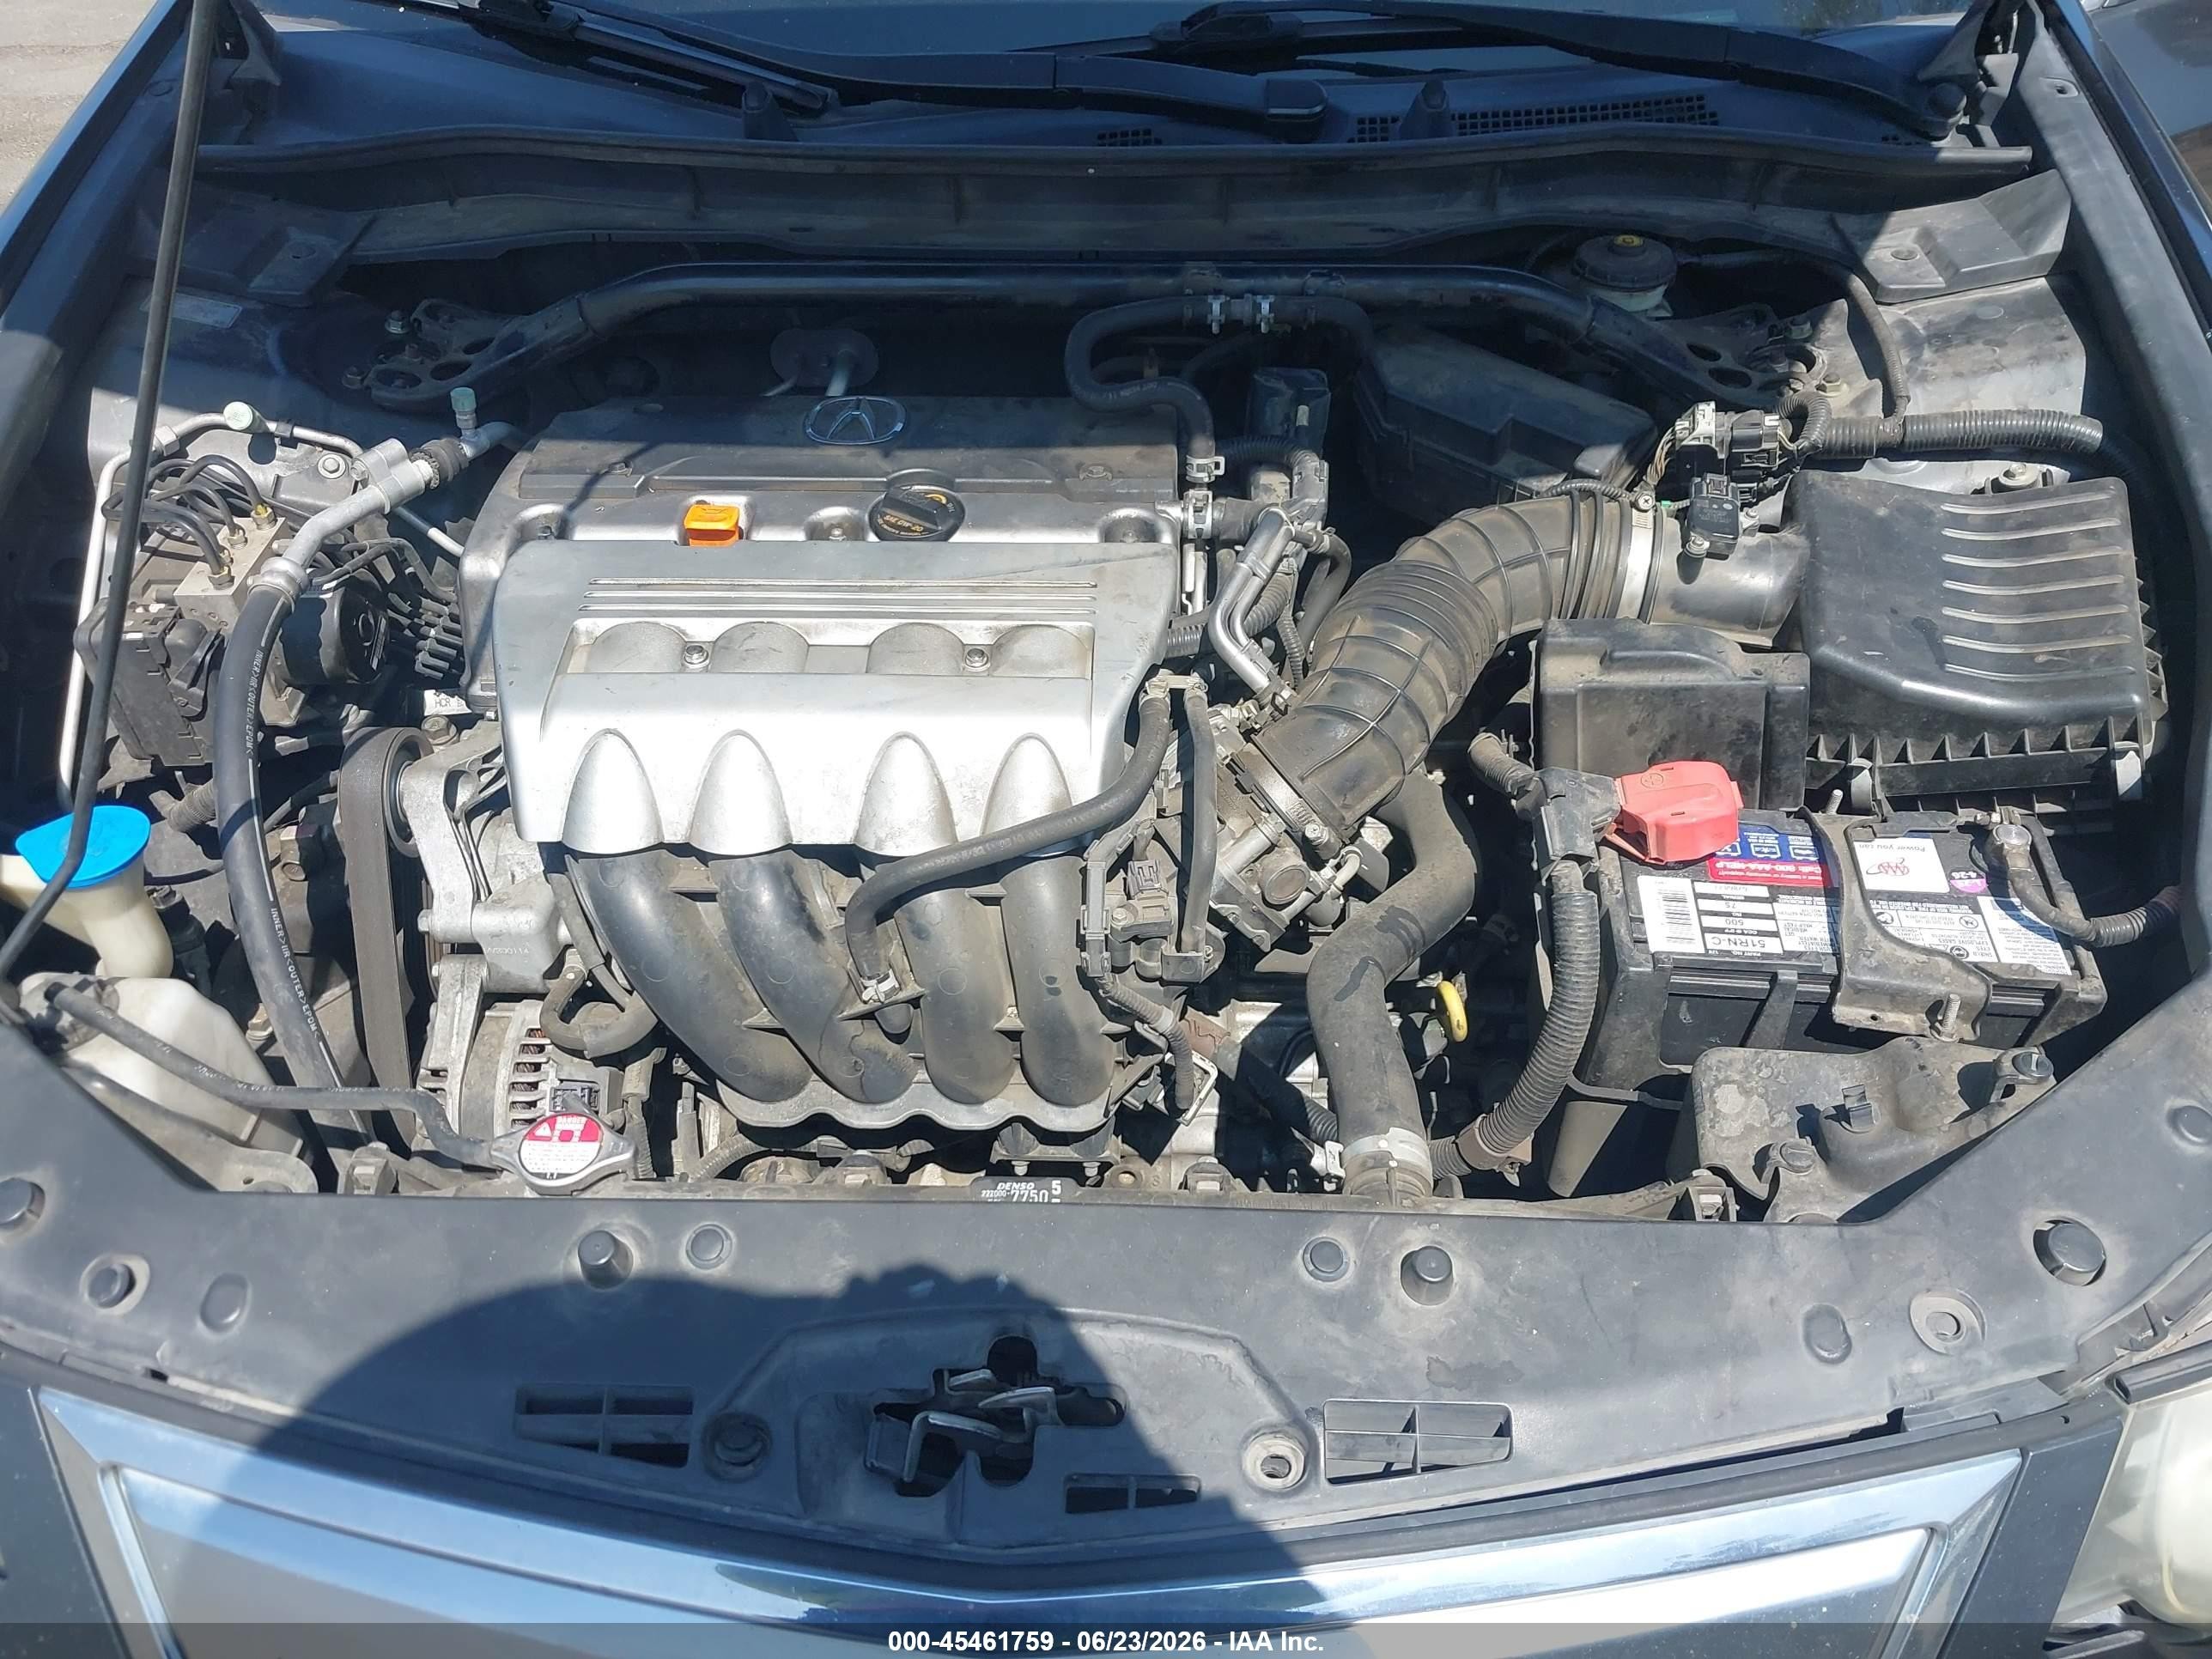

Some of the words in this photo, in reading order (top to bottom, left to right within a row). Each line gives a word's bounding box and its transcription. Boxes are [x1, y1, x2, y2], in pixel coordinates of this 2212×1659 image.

[1711, 936, 1765, 949] 51RN-C
[996, 1182, 1036, 1190] DENSO
[1051, 1180, 1061, 1194] 5
